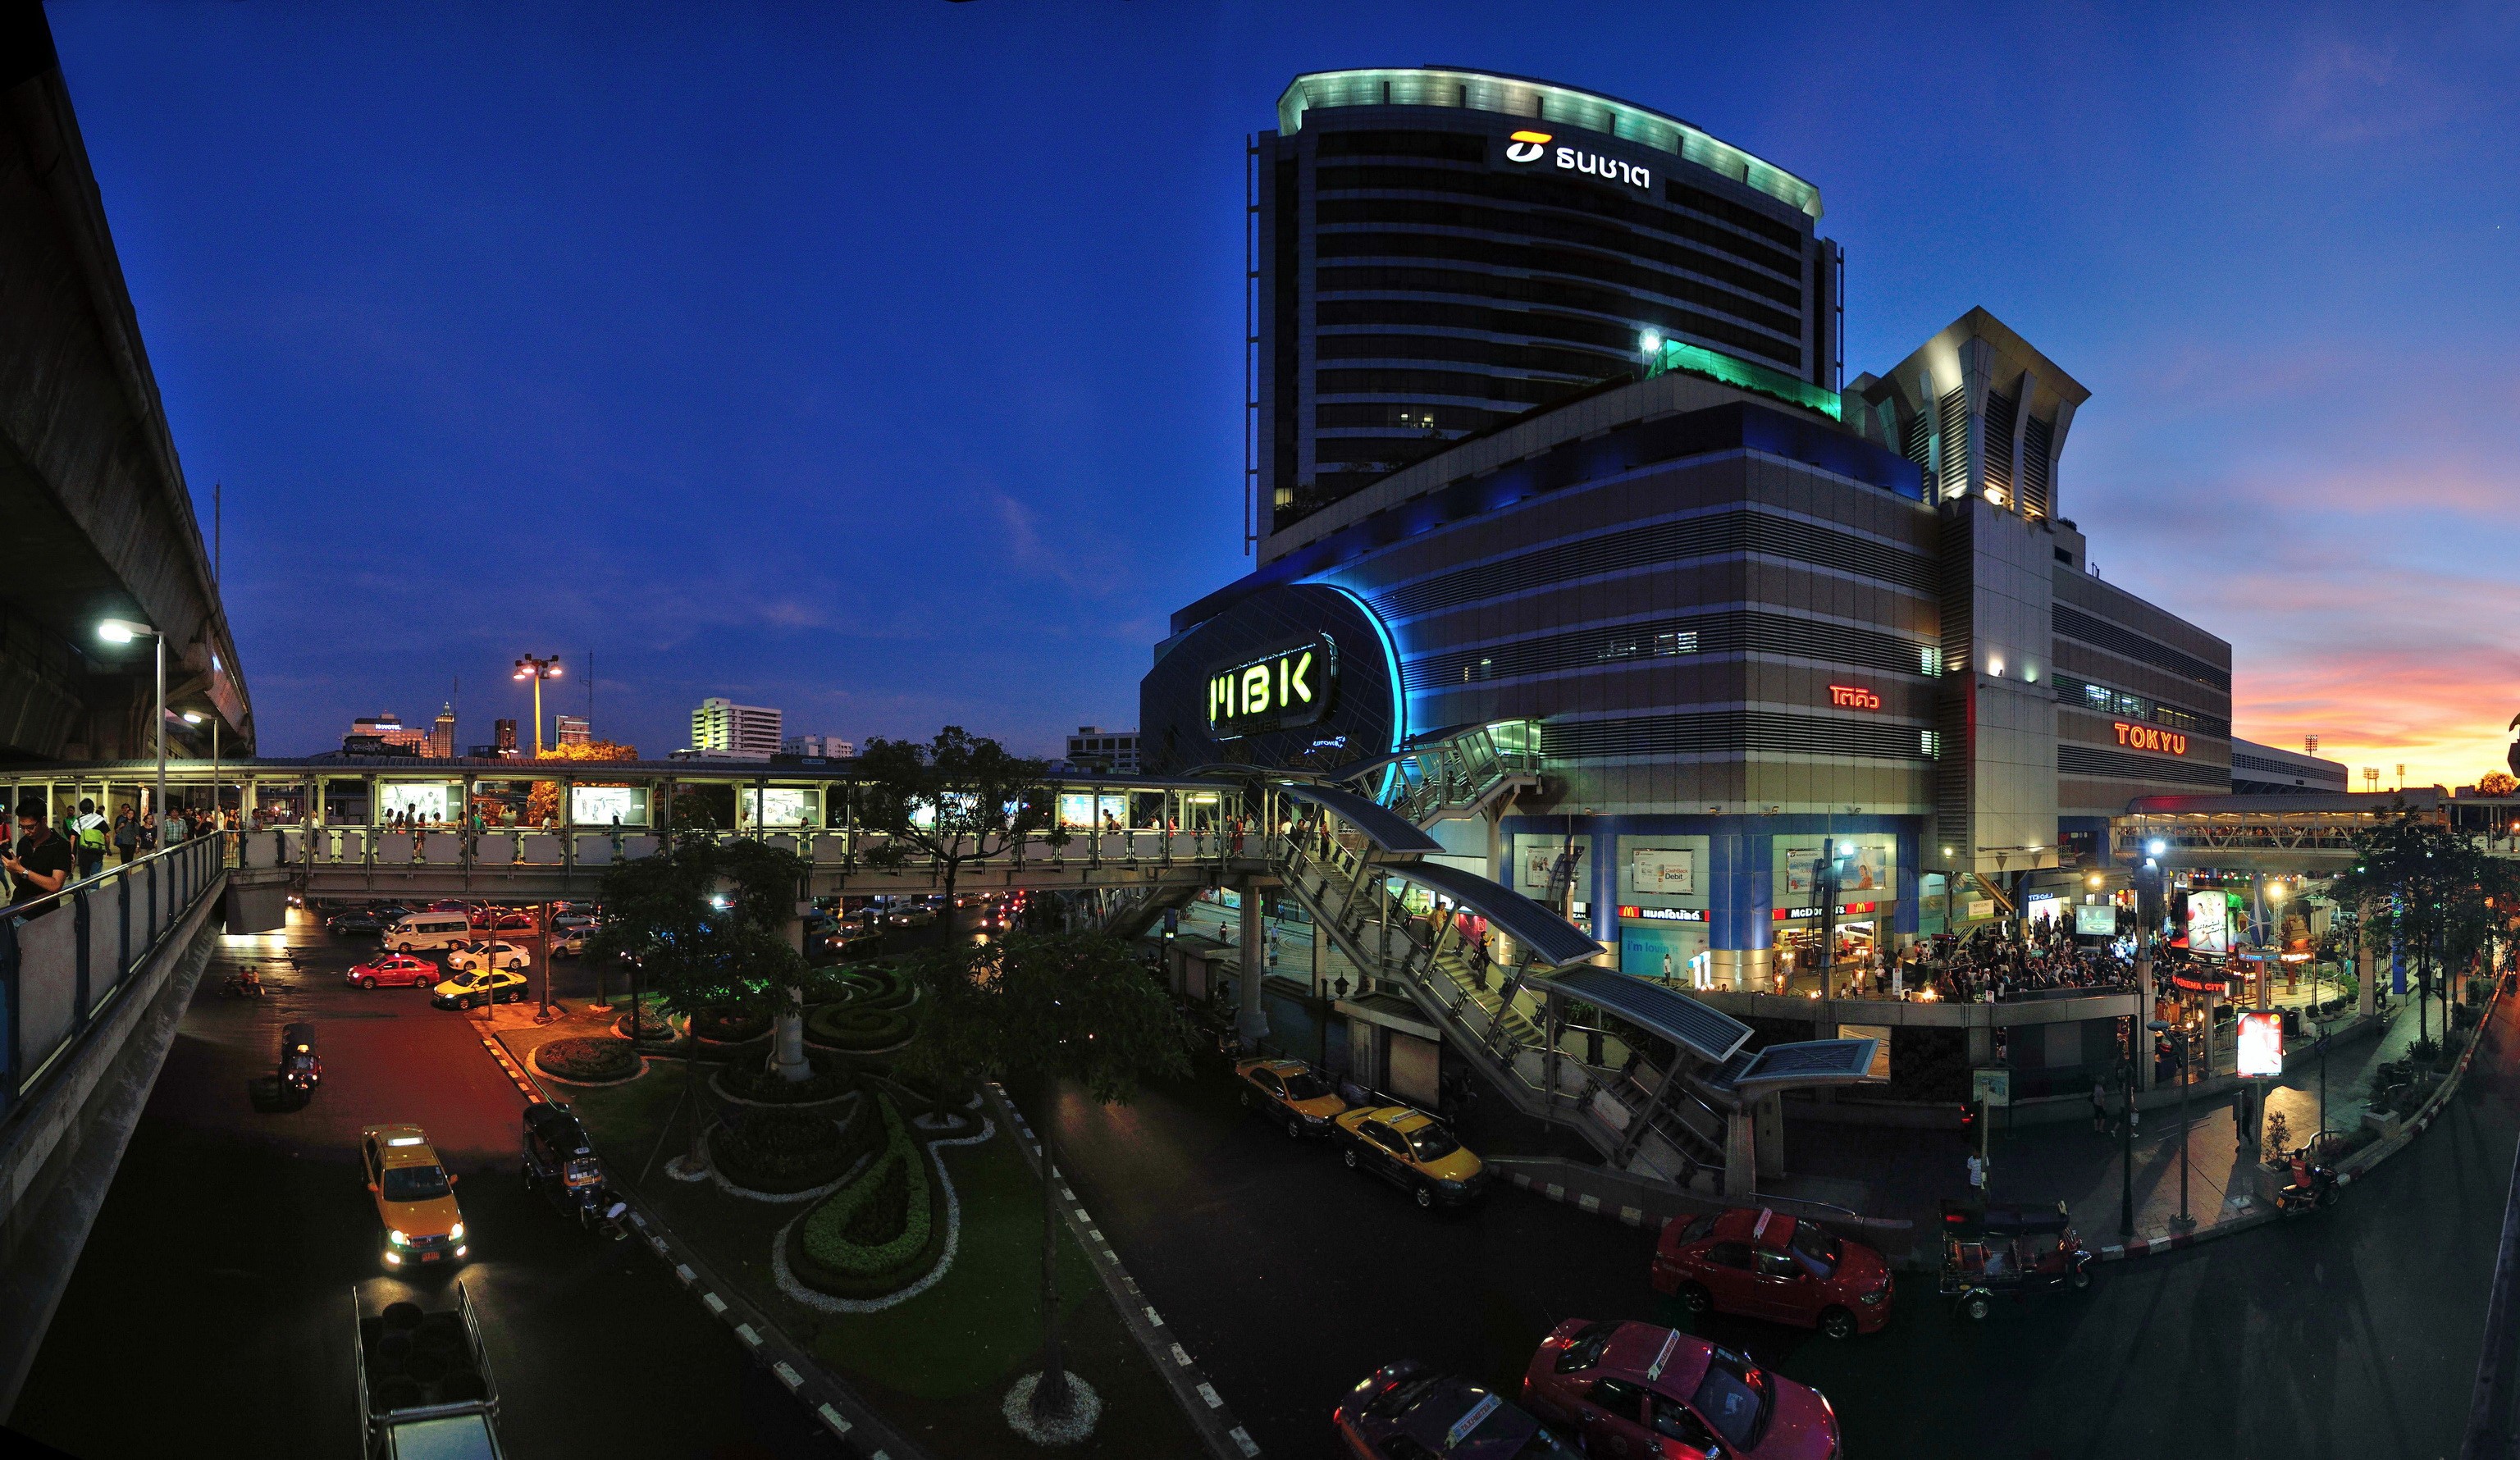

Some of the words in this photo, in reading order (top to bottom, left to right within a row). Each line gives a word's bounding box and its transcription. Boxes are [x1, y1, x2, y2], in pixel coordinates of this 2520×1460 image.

[1556, 147, 1650, 189] ธนชาต
[1209, 651, 1312, 722] MBK
[2114, 722, 2186, 755] TOKYU
[2176, 978, 2203, 990] CINEMA
[2204, 983, 2226, 992] CITY
